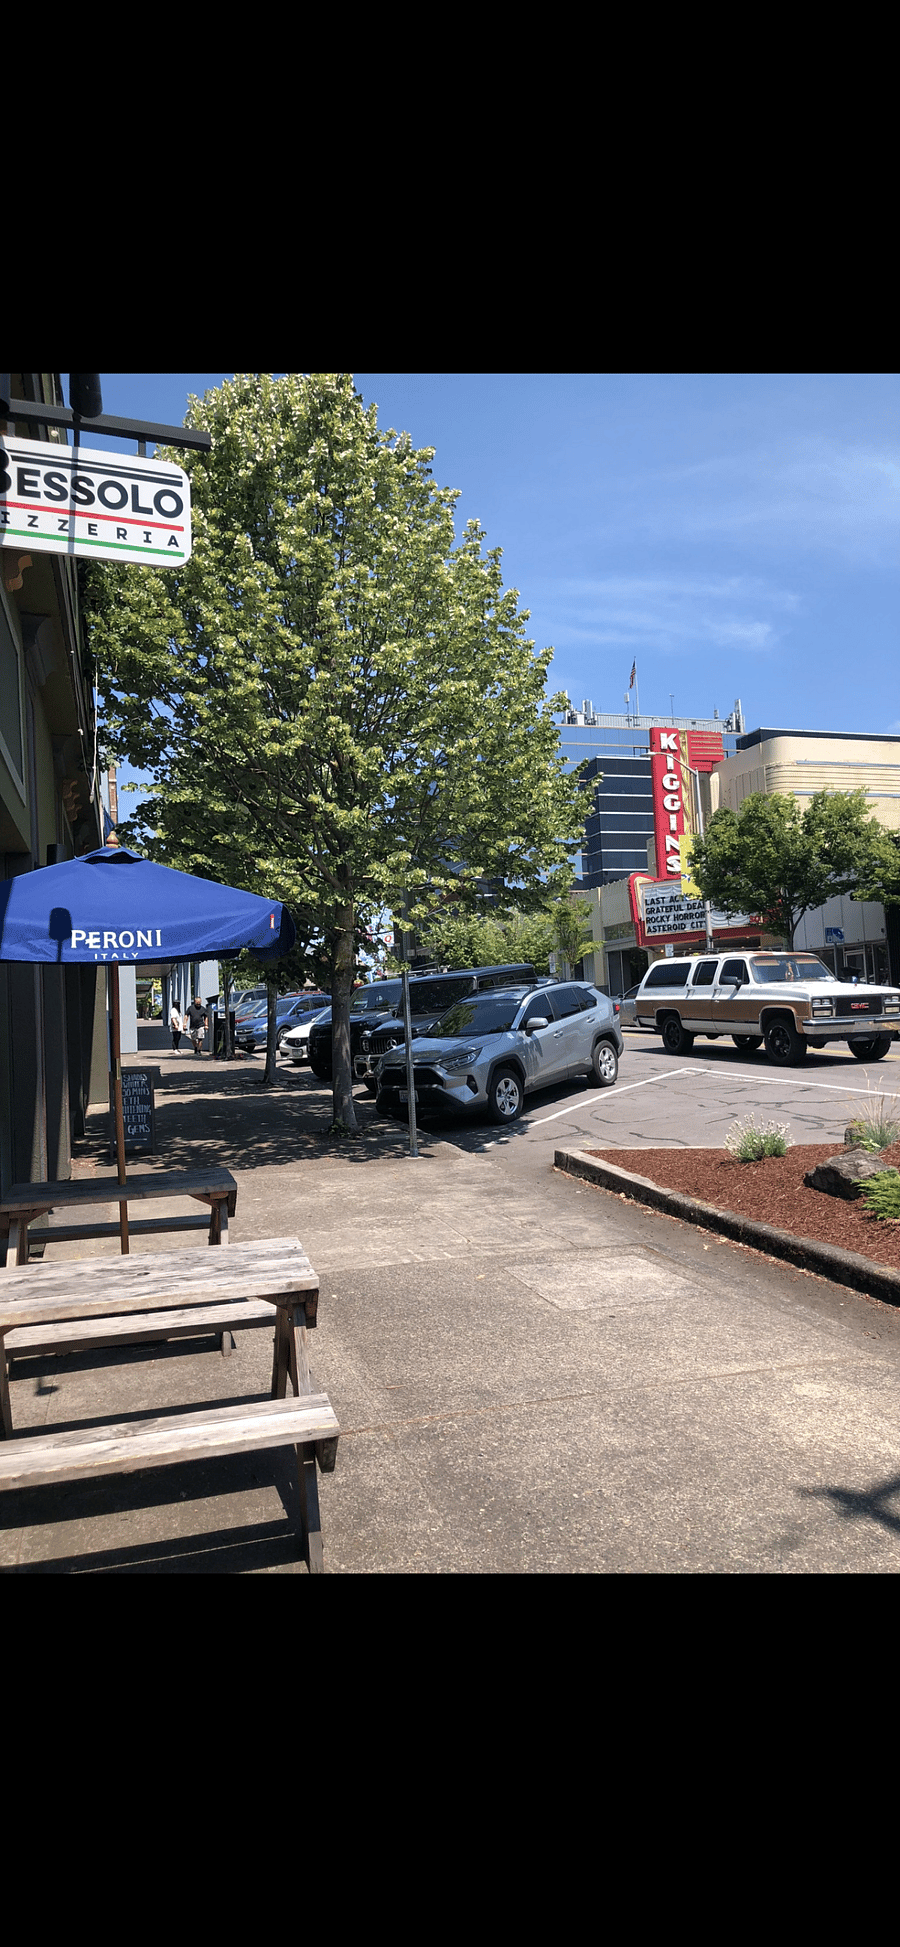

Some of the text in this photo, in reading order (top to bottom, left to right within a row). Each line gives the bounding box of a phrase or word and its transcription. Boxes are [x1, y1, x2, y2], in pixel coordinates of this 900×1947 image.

[659, 732, 681, 874] KIGGINS
[645, 897, 665, 905] LAST
[646, 905, 684, 914] GRATEFUL
[646, 911, 706, 924] ROCKY HORROR
[647, 923, 686, 933] ASTEROID
[70, 929, 162, 949] PERONI
[94, 951, 139, 960] ITALY
[851, 1002, 869, 1010] GMC
[128, 1124, 150, 1135] GEMS
